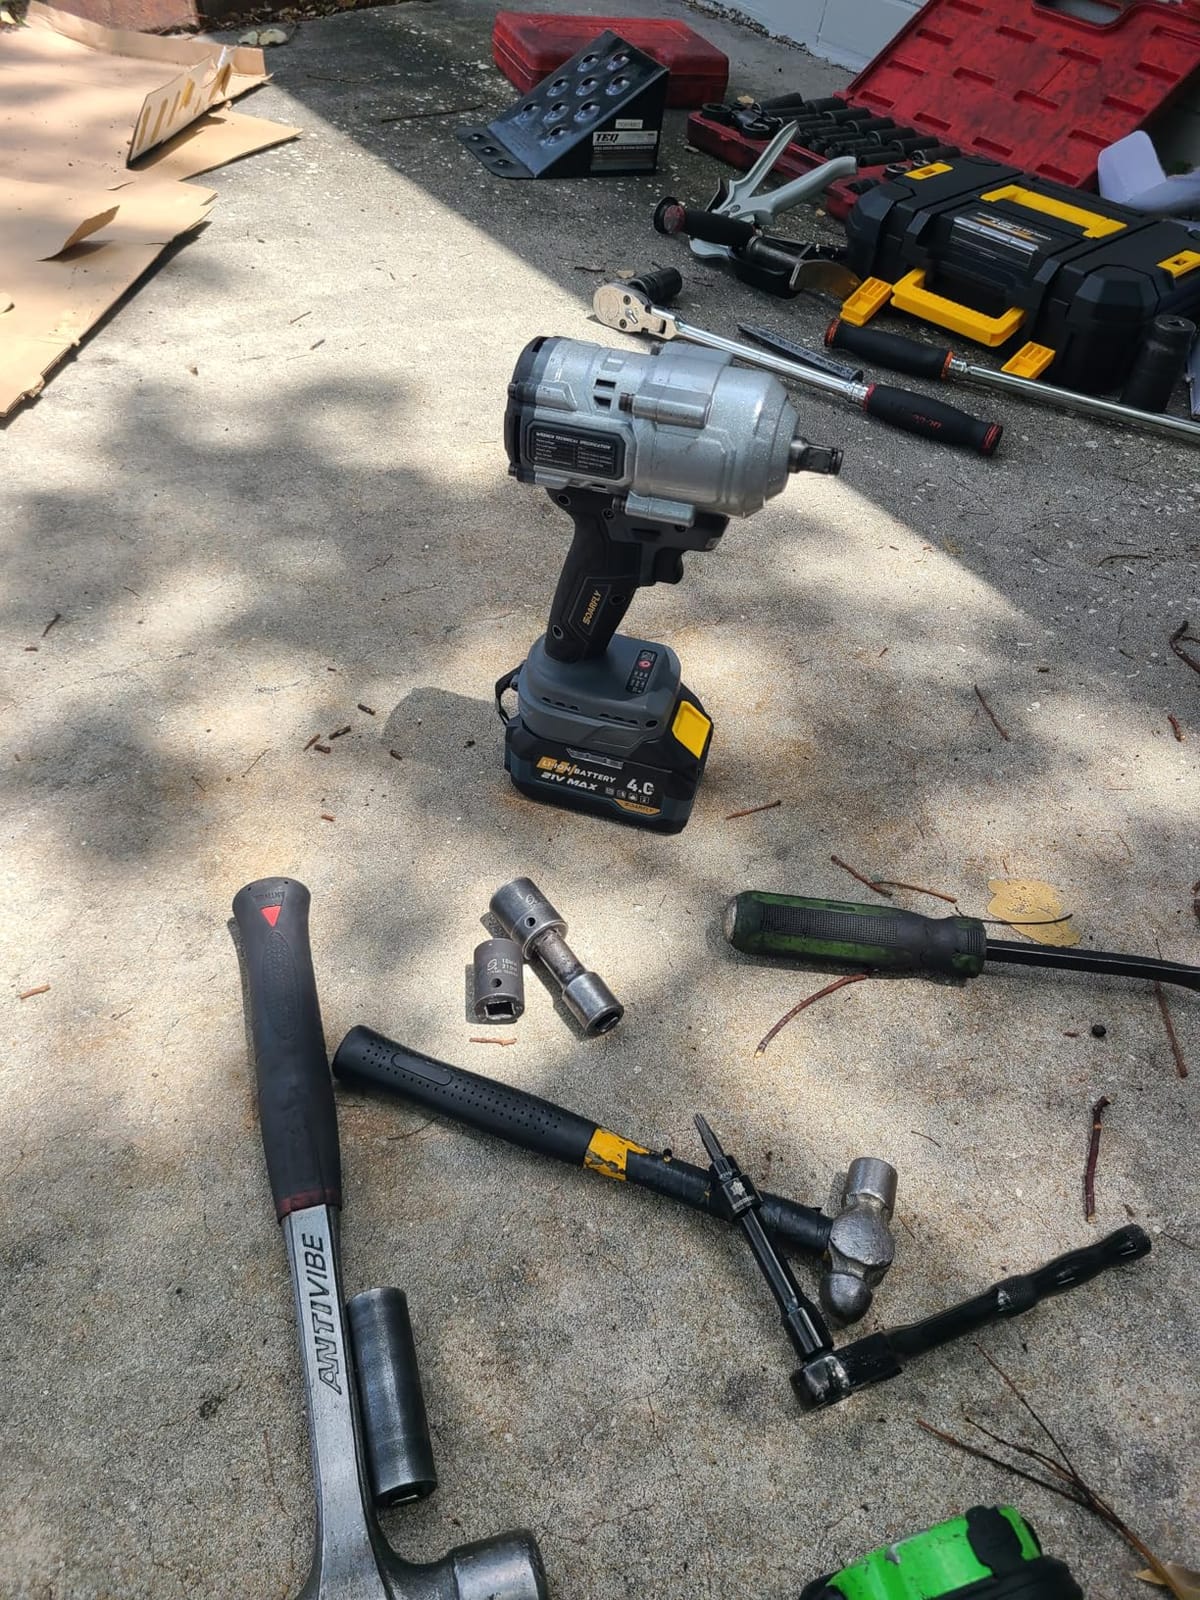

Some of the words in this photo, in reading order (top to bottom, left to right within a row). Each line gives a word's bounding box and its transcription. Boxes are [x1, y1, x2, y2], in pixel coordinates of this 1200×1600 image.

[596, 133, 619, 143] TEQ
[582, 590, 601, 625] SOARFLY
[541, 771, 566, 783] 21V
[566, 778, 598, 791] MAX
[302, 1233, 342, 1395] ANTIVIBE
